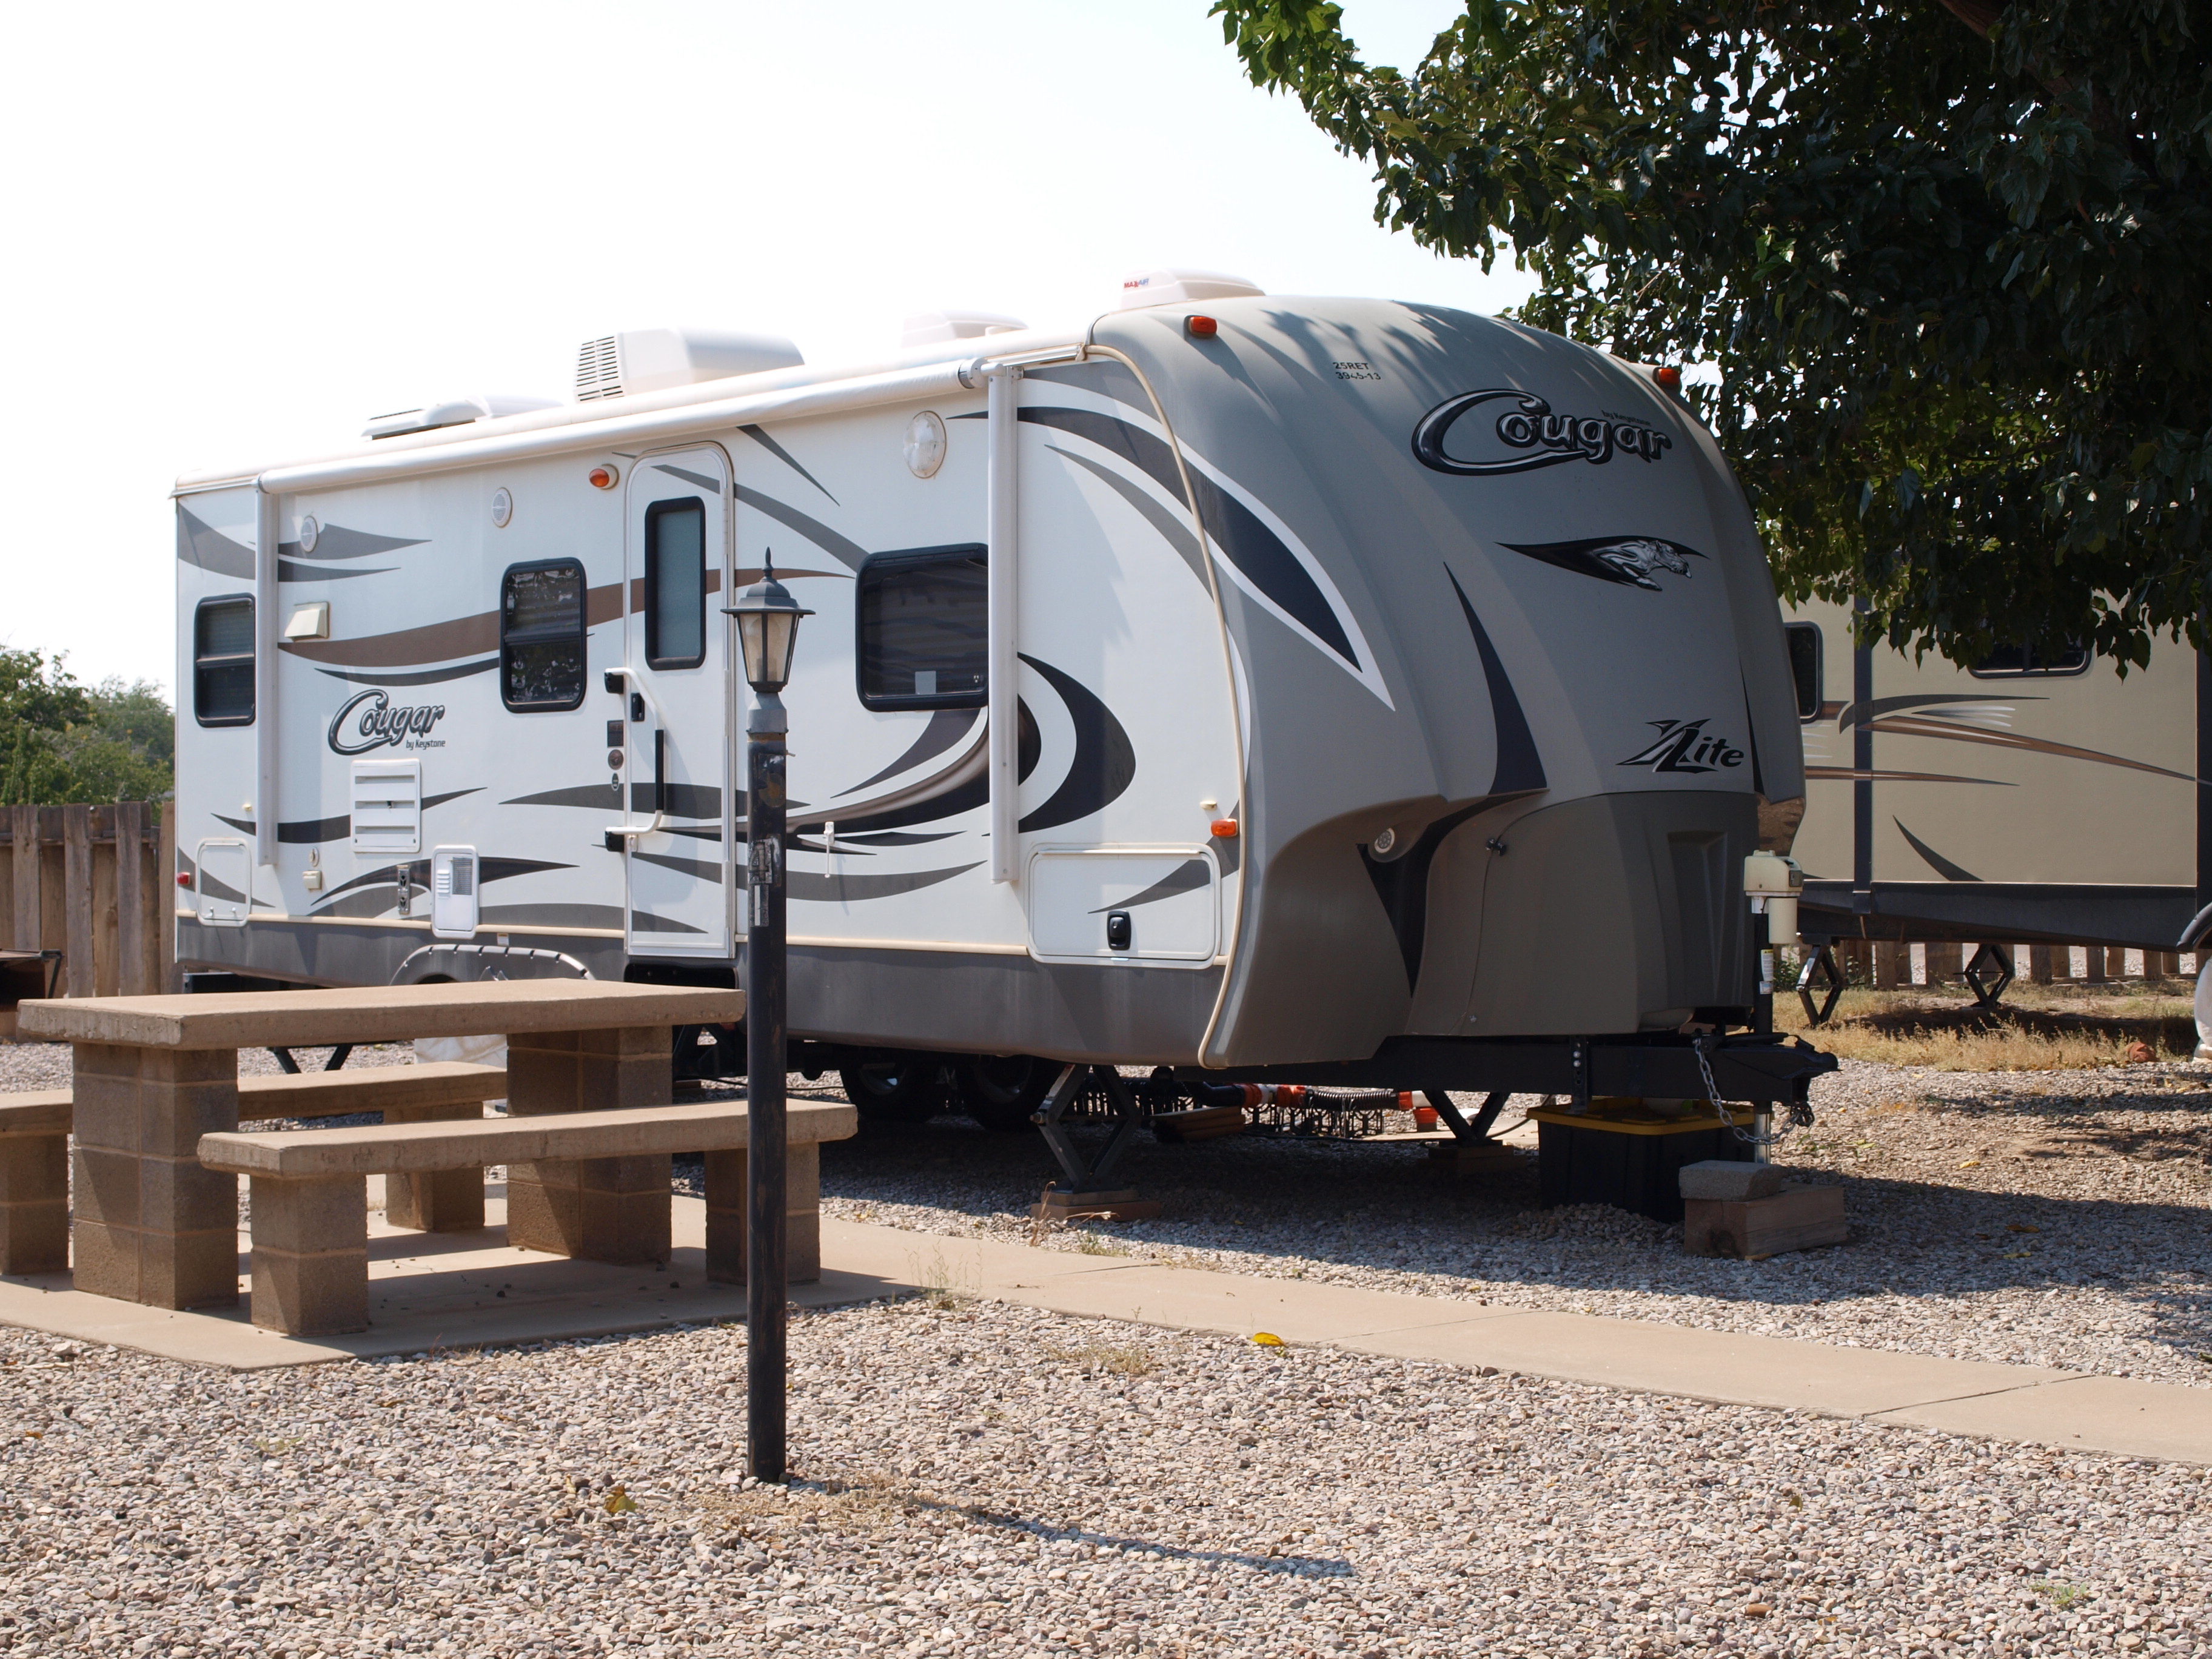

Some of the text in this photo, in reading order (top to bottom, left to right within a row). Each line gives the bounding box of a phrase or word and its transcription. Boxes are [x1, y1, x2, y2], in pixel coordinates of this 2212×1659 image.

[1335, 372, 1382, 380] 3945-13
[1411, 388, 1673, 476] Cougar
[327, 689, 446, 756] Cougar
[406, 739, 446, 751] by Keystone
